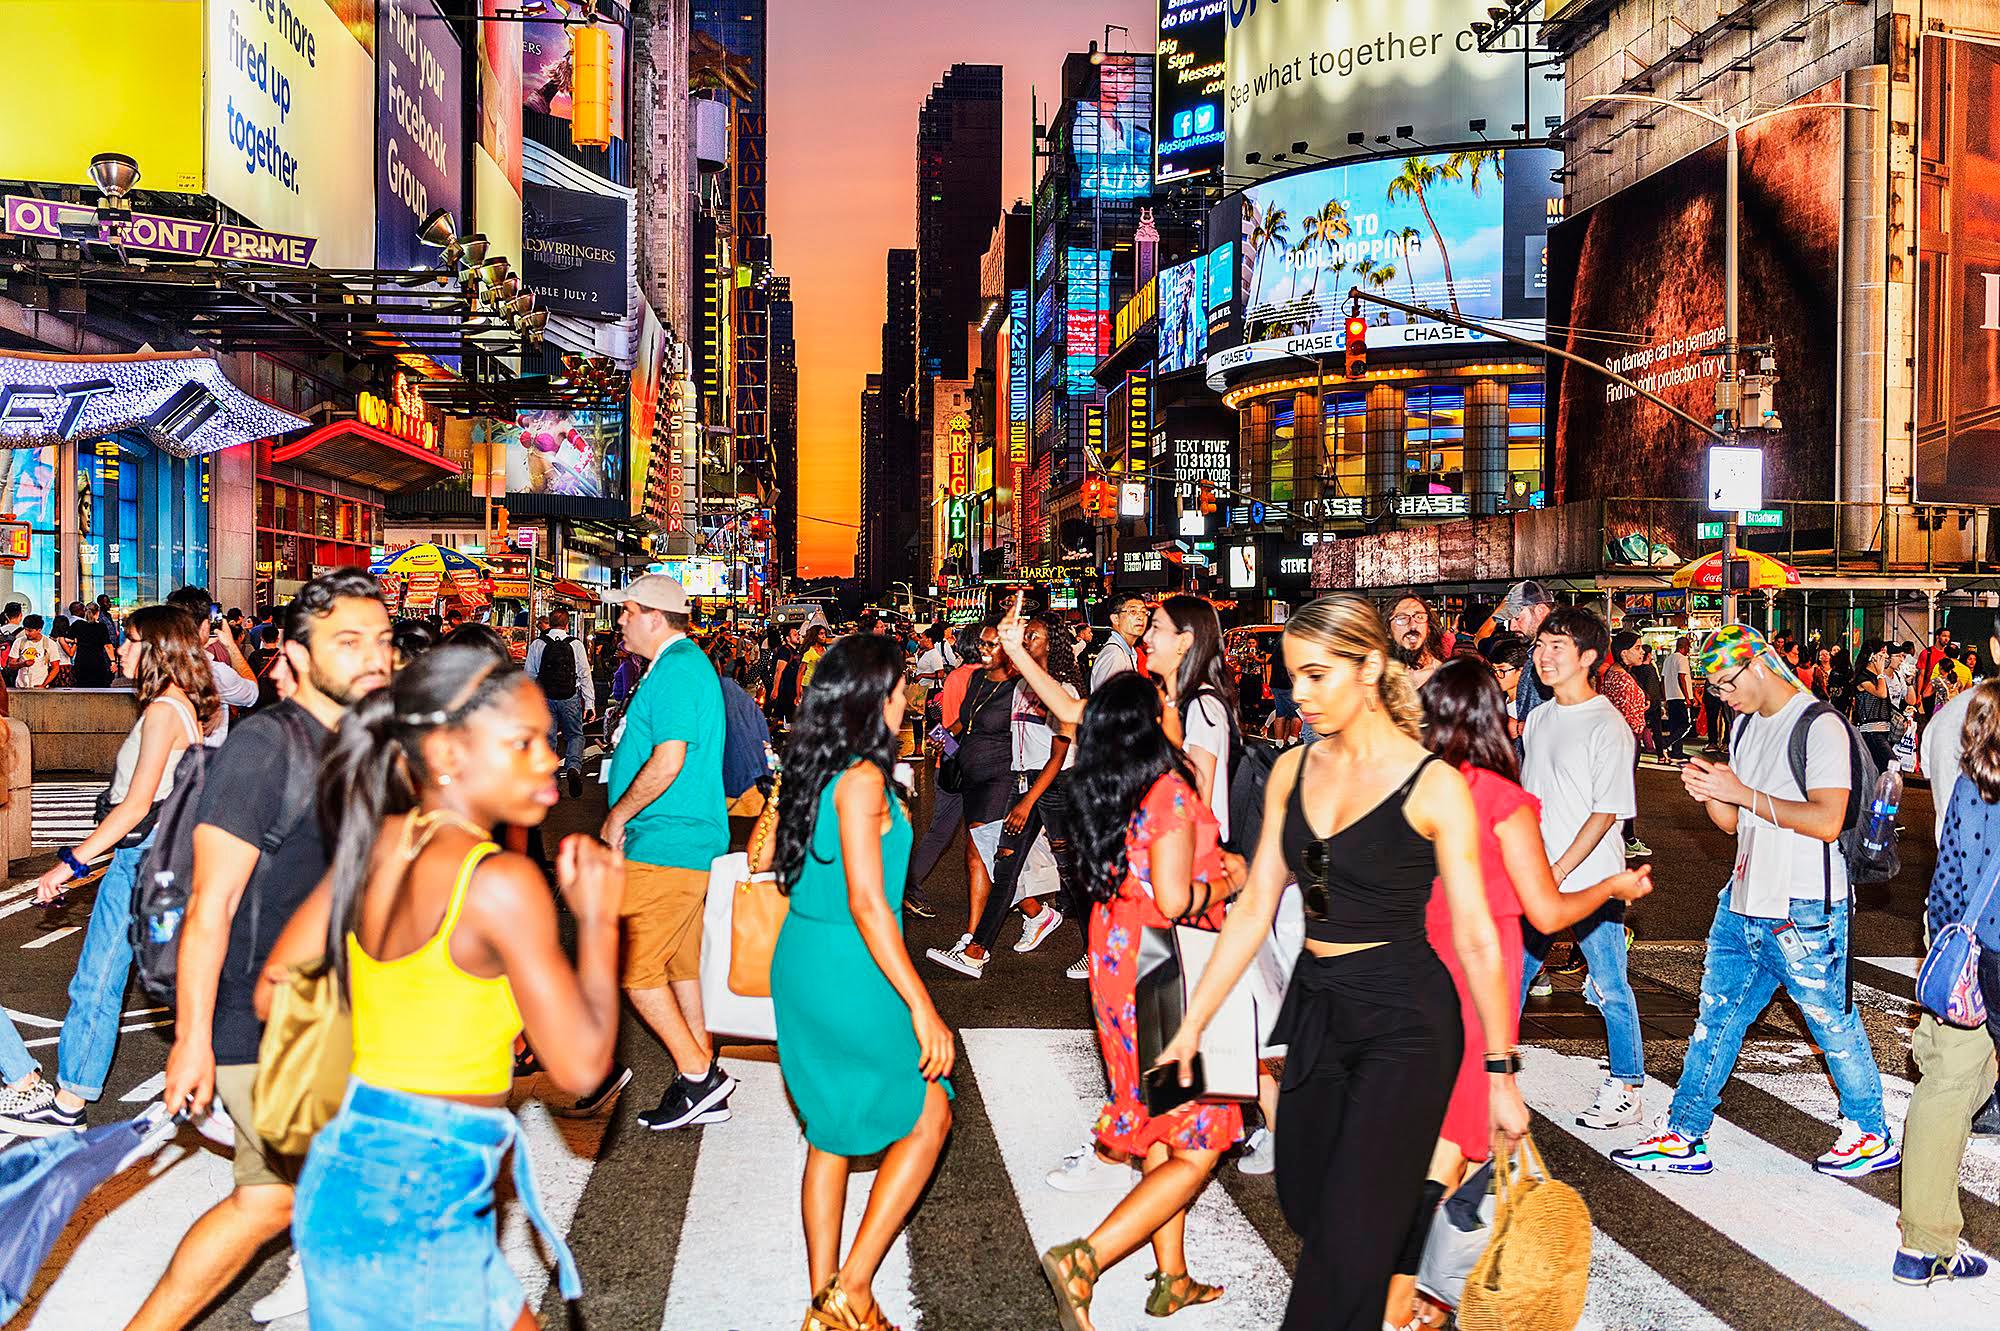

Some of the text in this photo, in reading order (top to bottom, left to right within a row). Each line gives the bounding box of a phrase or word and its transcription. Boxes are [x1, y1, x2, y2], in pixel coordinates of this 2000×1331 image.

[1161, 13, 1177, 29] do
[1179, 9, 1199, 24] for
[279, 0, 316, 68] more
[1159, 38, 1178, 54] Big
[388, 0, 445, 101] Find your
[1167, 52, 1195, 69] Sign
[228, 9, 267, 94] fired
[271, 66, 290, 124] up
[1230, 25, 1520, 114] See what together cn
[388, 60, 448, 177] Facebook
[227, 95, 300, 195] together.
[15, 203, 307, 263] OURONT PRIME
[1315, 213, 1378, 241] YES TO
[1285, 235, 1421, 272] POOL HOPPING
[523, 284, 598, 302] ABLE JULY 2
[1011, 289, 1027, 318] NEW
[1287, 335, 1333, 353] CHASE
[1404, 326, 1465, 341] CHASE
[1221, 347, 1244, 367] CHASE
[1605, 325, 1726, 373] Sun damage can be permane
[1606, 382, 1622, 403] Find
[1658, 361, 1700, 393] protection
[1702, 357, 1715, 377] for
[1716, 356, 1727, 378] yo
[1010, 367, 1027, 421] STUDIOS
[1131, 376, 1146, 449] VICTORY
[669, 381, 684, 532] AMSTERDAM
[1011, 426, 1026, 462] DUKE
[1174, 440, 1199, 453] TEXT
[455, 460, 472, 470] AIL
[1174, 453, 1231, 468] TO 313131
[950, 433, 967, 539] REGAL
[1174, 468, 1230, 481] TO PUT YOUR
[1174, 482, 1231, 498] AD HRE!
[1304, 497, 1363, 518] CASE
[1389, 495, 1467, 514] HASE
[1747, 511, 1780, 526] Broadway
[1003, 543, 1011, 568] DANCE
[1280, 557, 1306, 574] STEVE
[1020, 565, 1098, 579] HARRY POER
